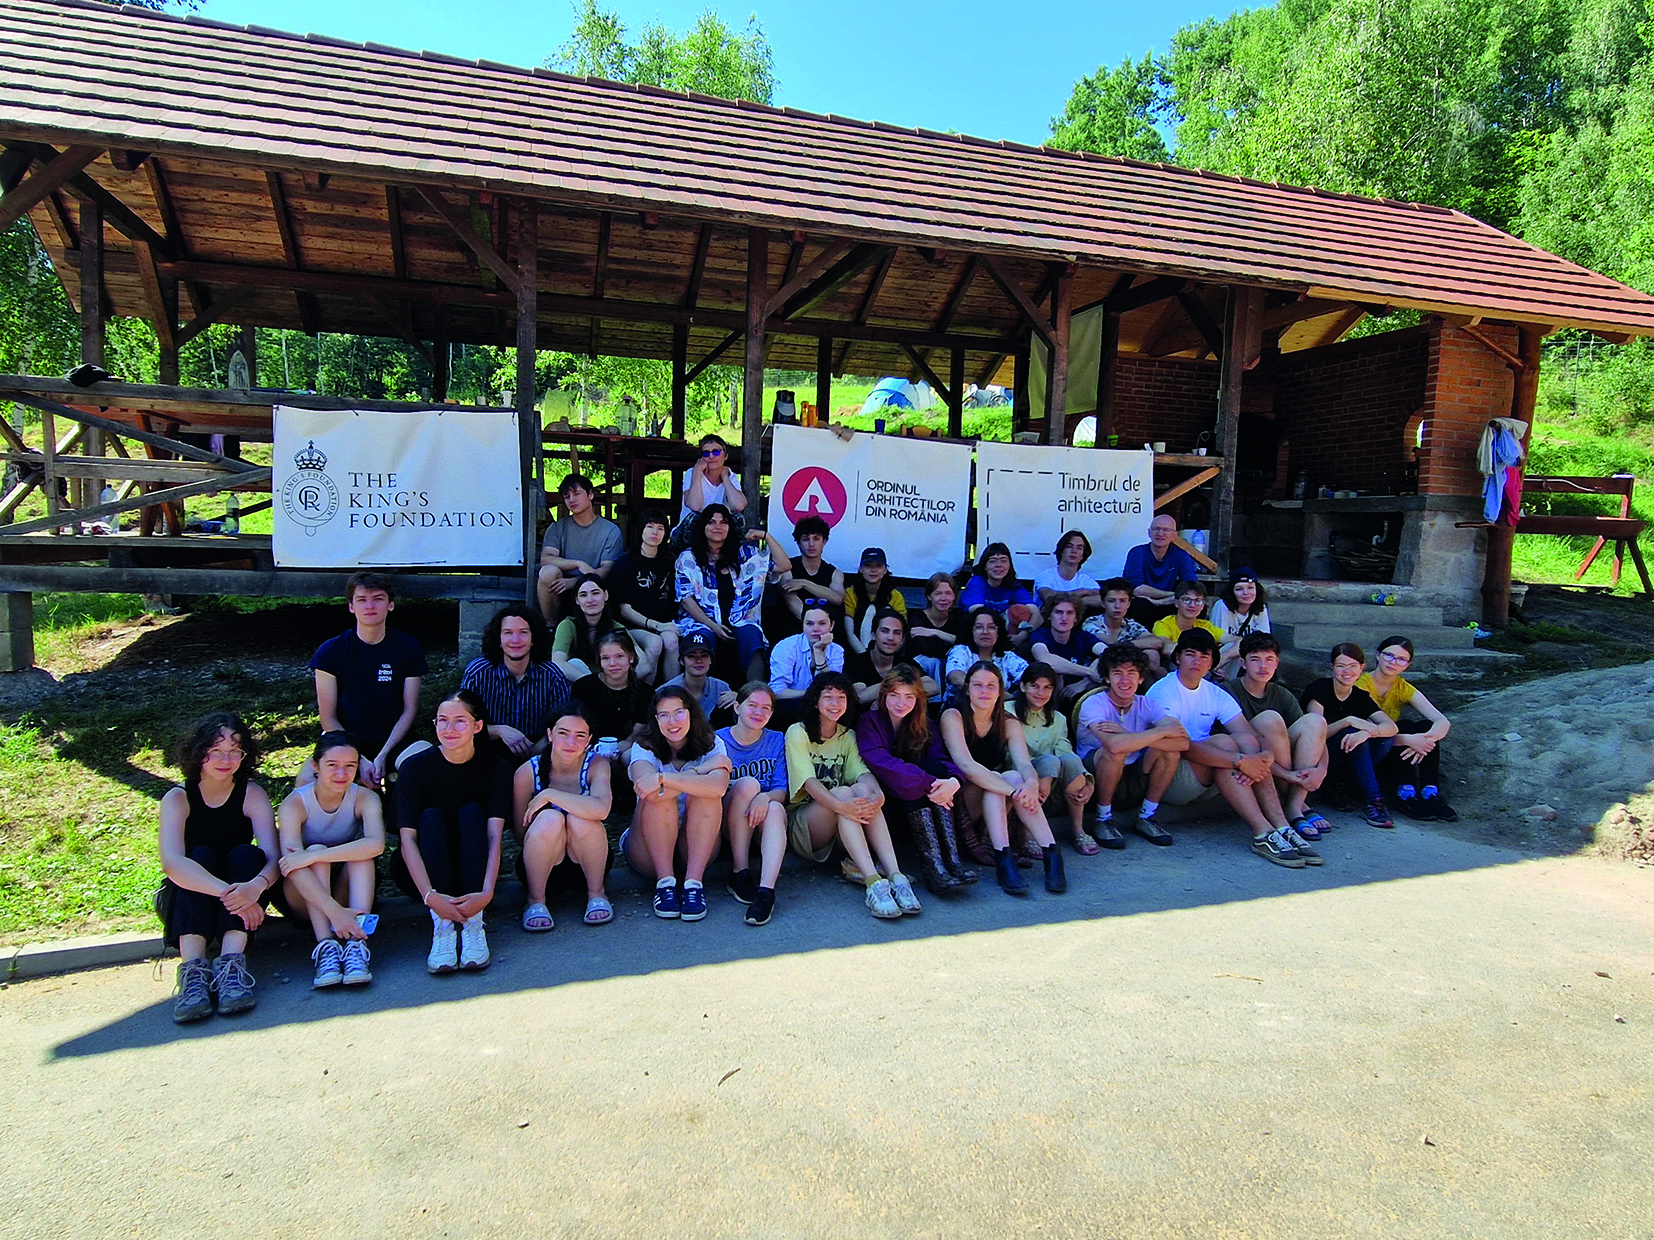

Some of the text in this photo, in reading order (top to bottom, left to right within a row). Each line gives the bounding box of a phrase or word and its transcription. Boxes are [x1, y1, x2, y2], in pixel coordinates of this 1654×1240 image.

[348, 471, 397, 488] THE
[867, 479, 921, 496] ORDINUL
[1058, 472, 1141, 491] Timbrul de
[348, 491, 429, 508] KING'S
[1057, 495, 1142, 514] arhitectură
[348, 512, 514, 529] FOUNDATION
[865, 505, 949, 524] DIN ROMÂNIA
[729, 757, 777, 781] noopy
